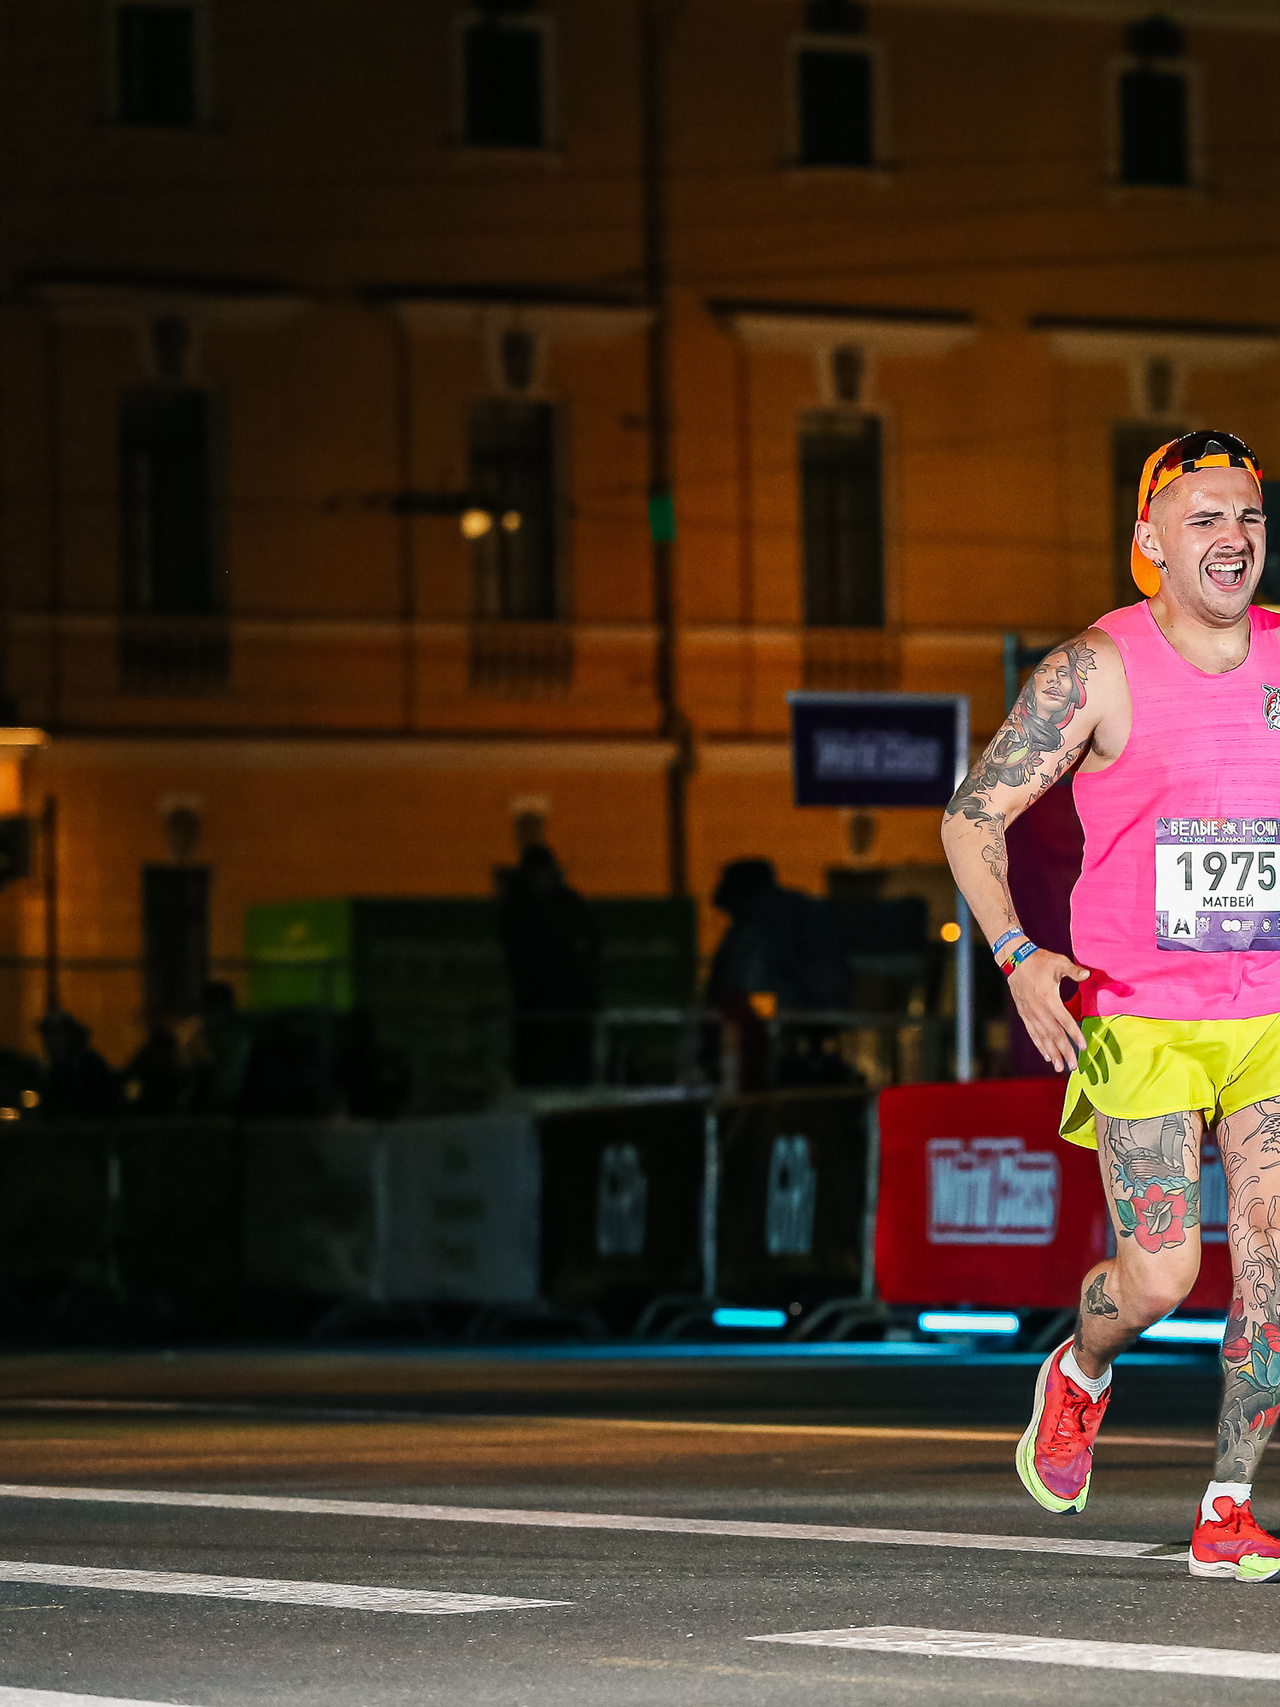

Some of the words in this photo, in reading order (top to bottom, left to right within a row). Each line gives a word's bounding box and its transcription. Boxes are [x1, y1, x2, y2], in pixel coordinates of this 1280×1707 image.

[1170, 820, 1220, 836] БЕЛЫЕ
[1242, 820, 1278, 836] НОЧИ
[1176, 851, 1277, 891] 1975
[1202, 894, 1254, 908] МАТВЕЙ
